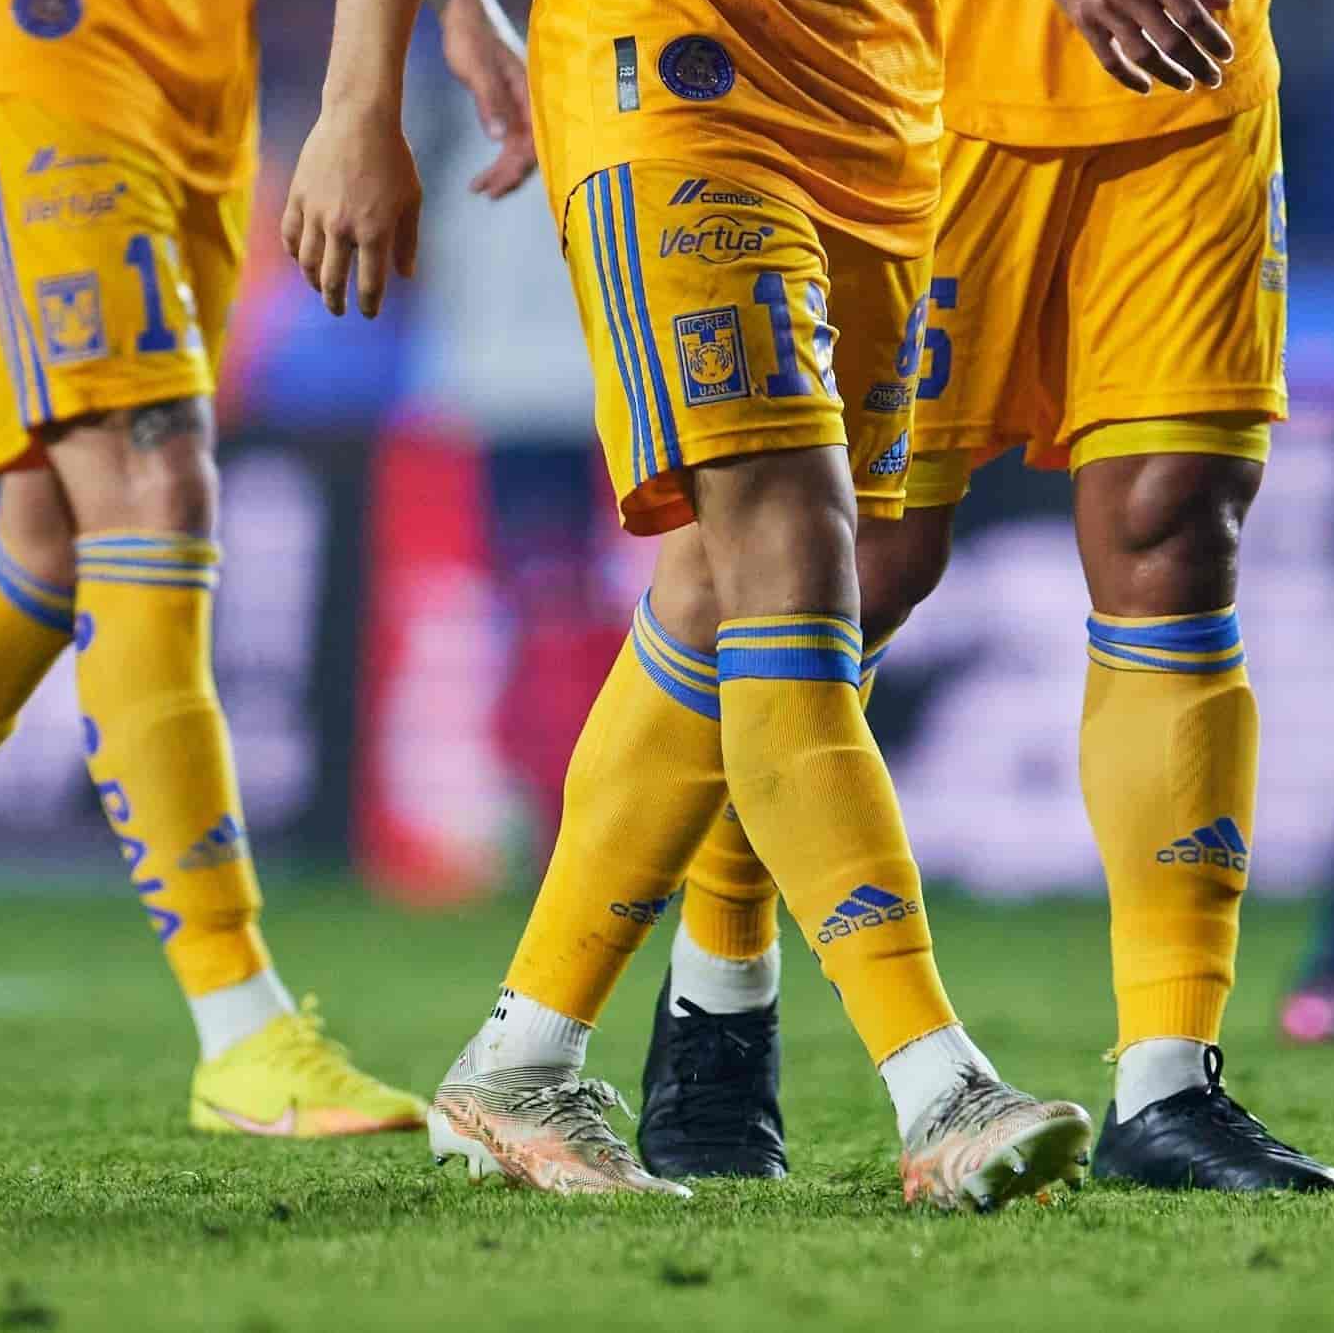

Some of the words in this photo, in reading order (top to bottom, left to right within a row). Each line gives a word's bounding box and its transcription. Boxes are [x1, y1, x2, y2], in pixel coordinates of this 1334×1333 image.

[659, 224, 764, 259] Vertua
[680, 316, 734, 336] TIGRES
[1155, 846, 1246, 873] adida
[817, 899, 919, 945] adidas
